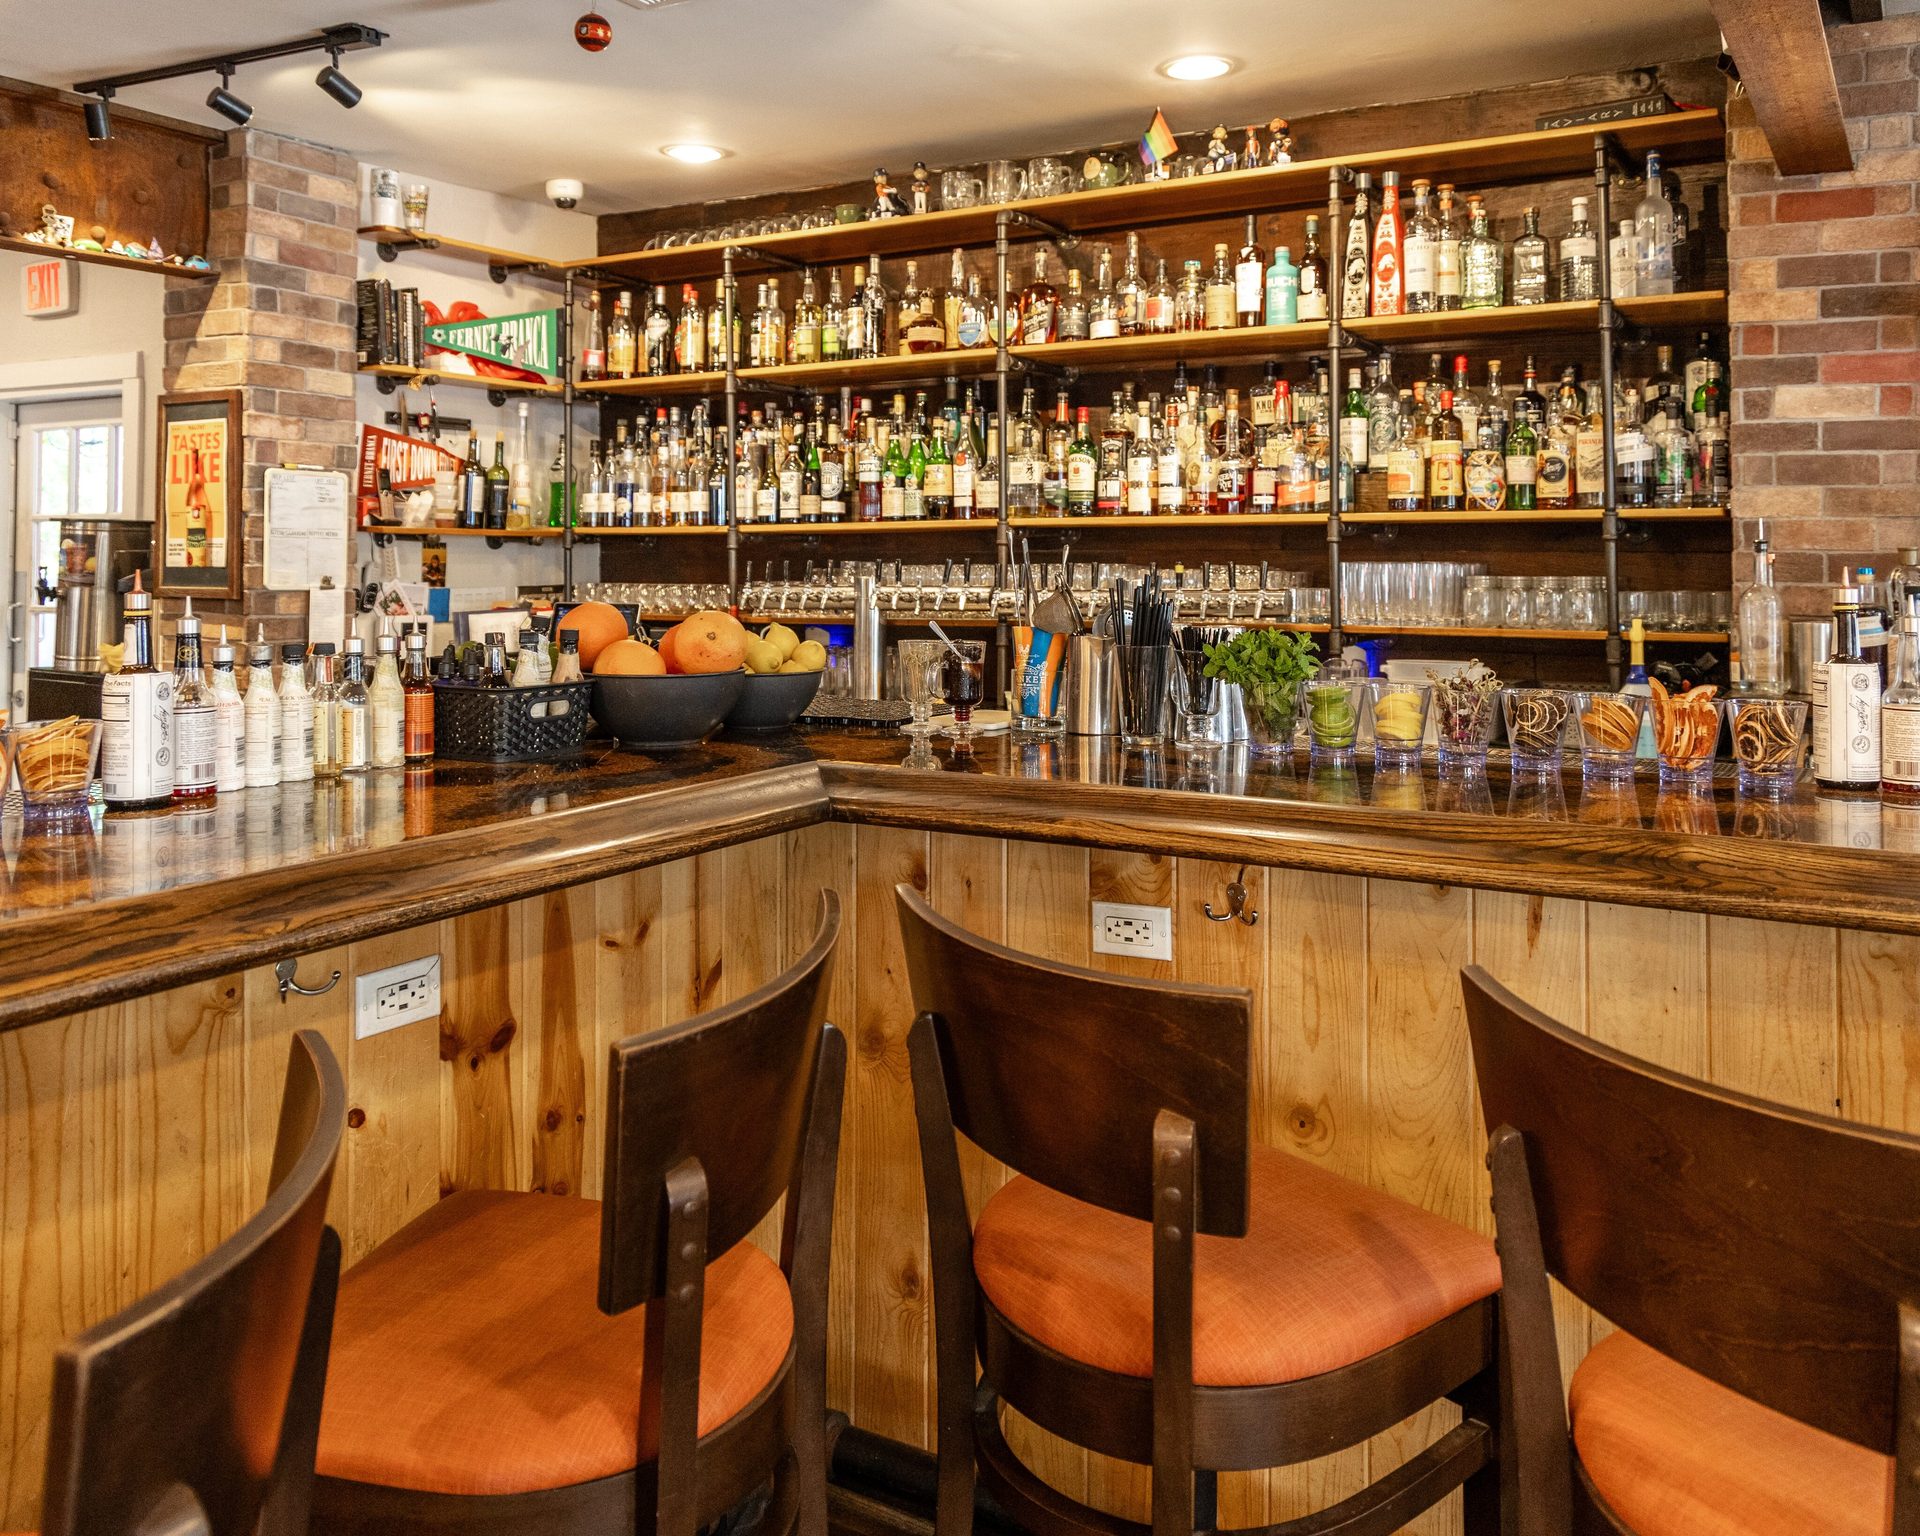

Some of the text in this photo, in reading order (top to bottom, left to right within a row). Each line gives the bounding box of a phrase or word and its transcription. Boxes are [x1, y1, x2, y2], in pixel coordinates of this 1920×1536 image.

[1550, 110, 1624, 128] AVIARY
[27, 262, 61, 311] EXIT
[449, 315, 549, 370] FERNETBRANCA
[173, 432, 221, 451] TASTES
[381, 437, 409, 483] FIRST
[410, 444, 438, 481] DOWN
[171, 452, 221, 484] LIKE
